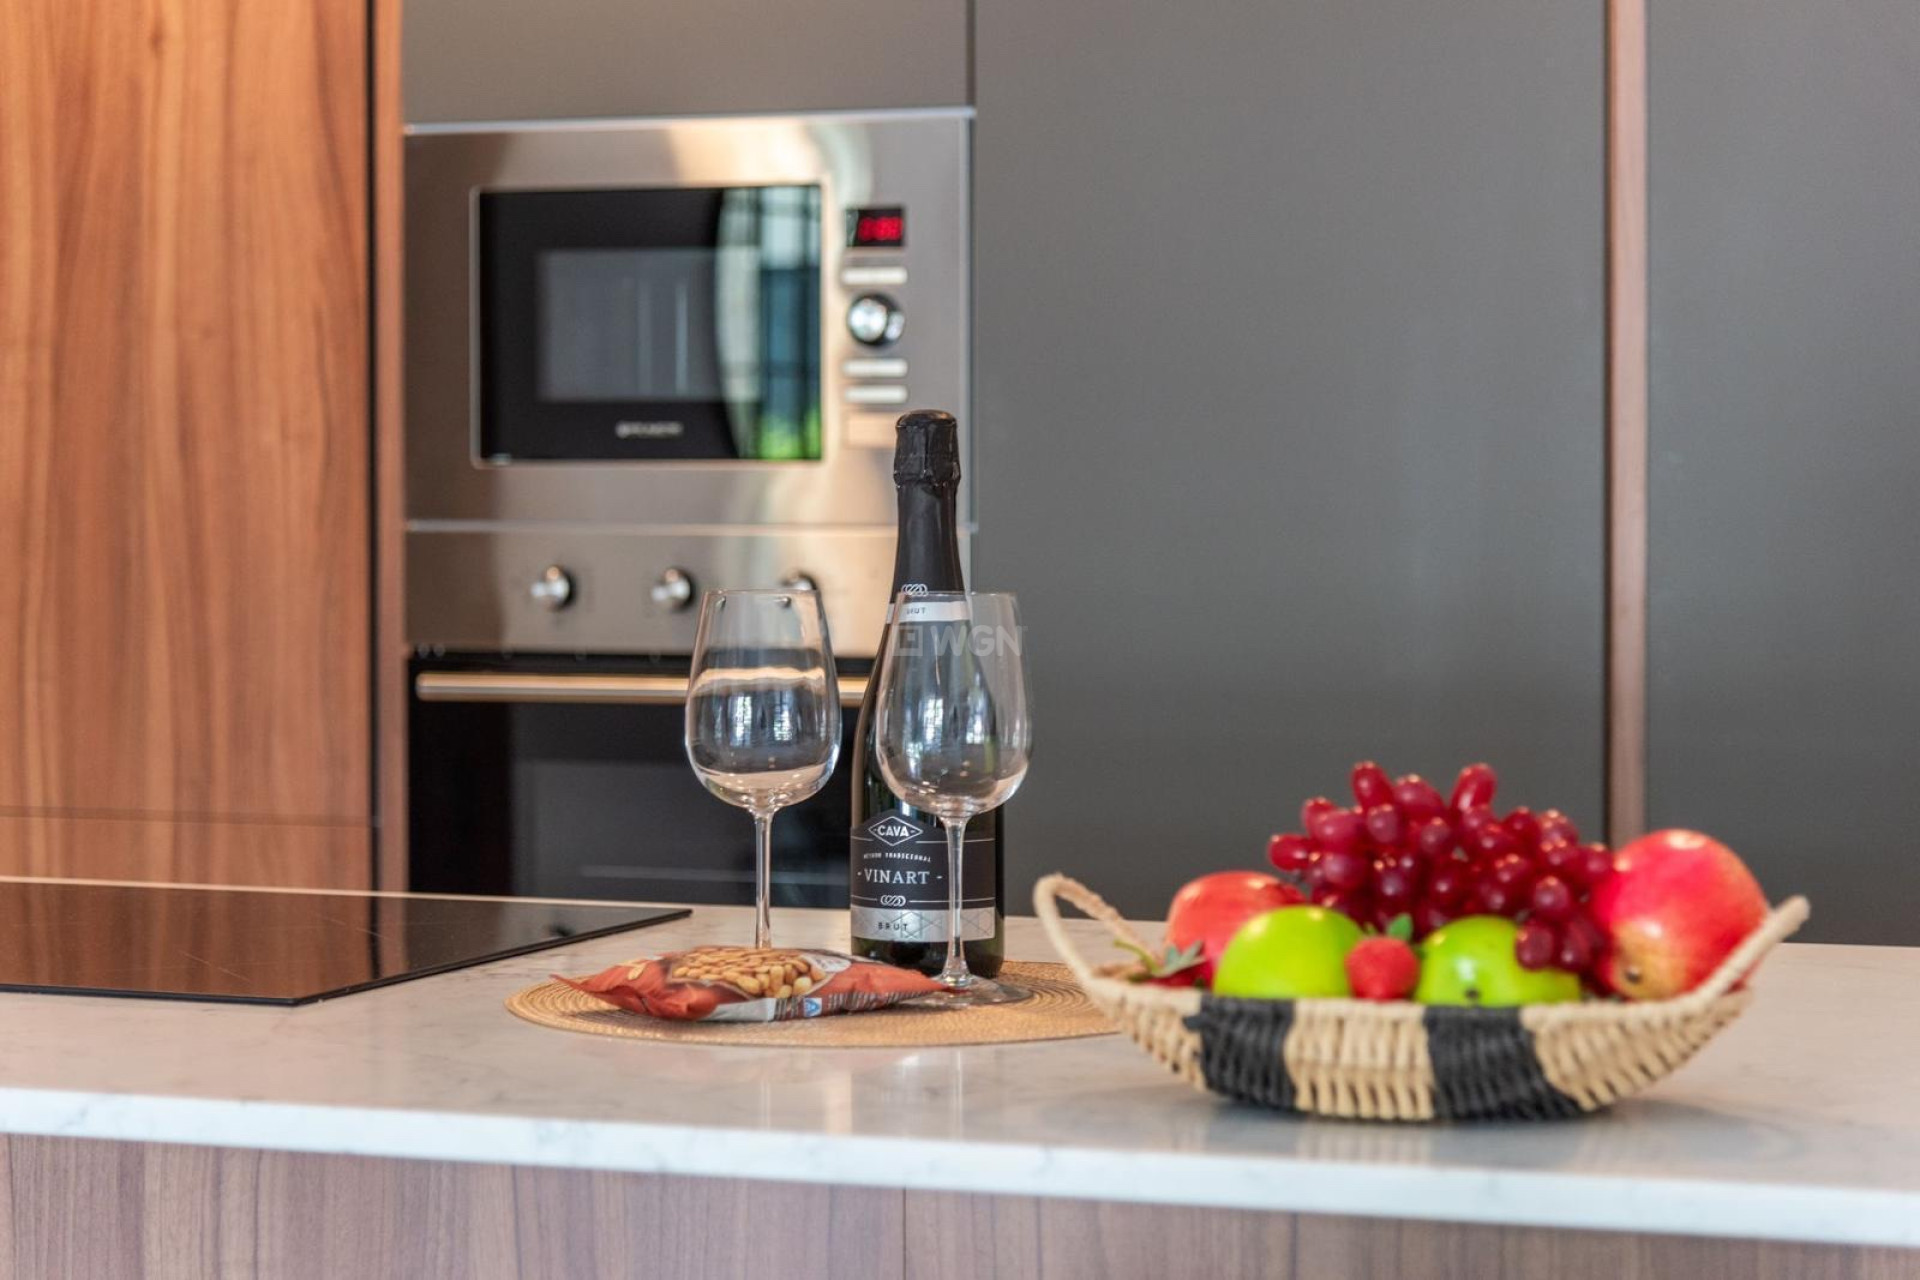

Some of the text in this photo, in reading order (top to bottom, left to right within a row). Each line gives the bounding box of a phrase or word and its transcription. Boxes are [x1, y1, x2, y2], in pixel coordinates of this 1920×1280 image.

[877, 825, 910, 837] CAVA
[864, 868, 930, 885] VINART
[878, 922, 909, 931] BRUT
